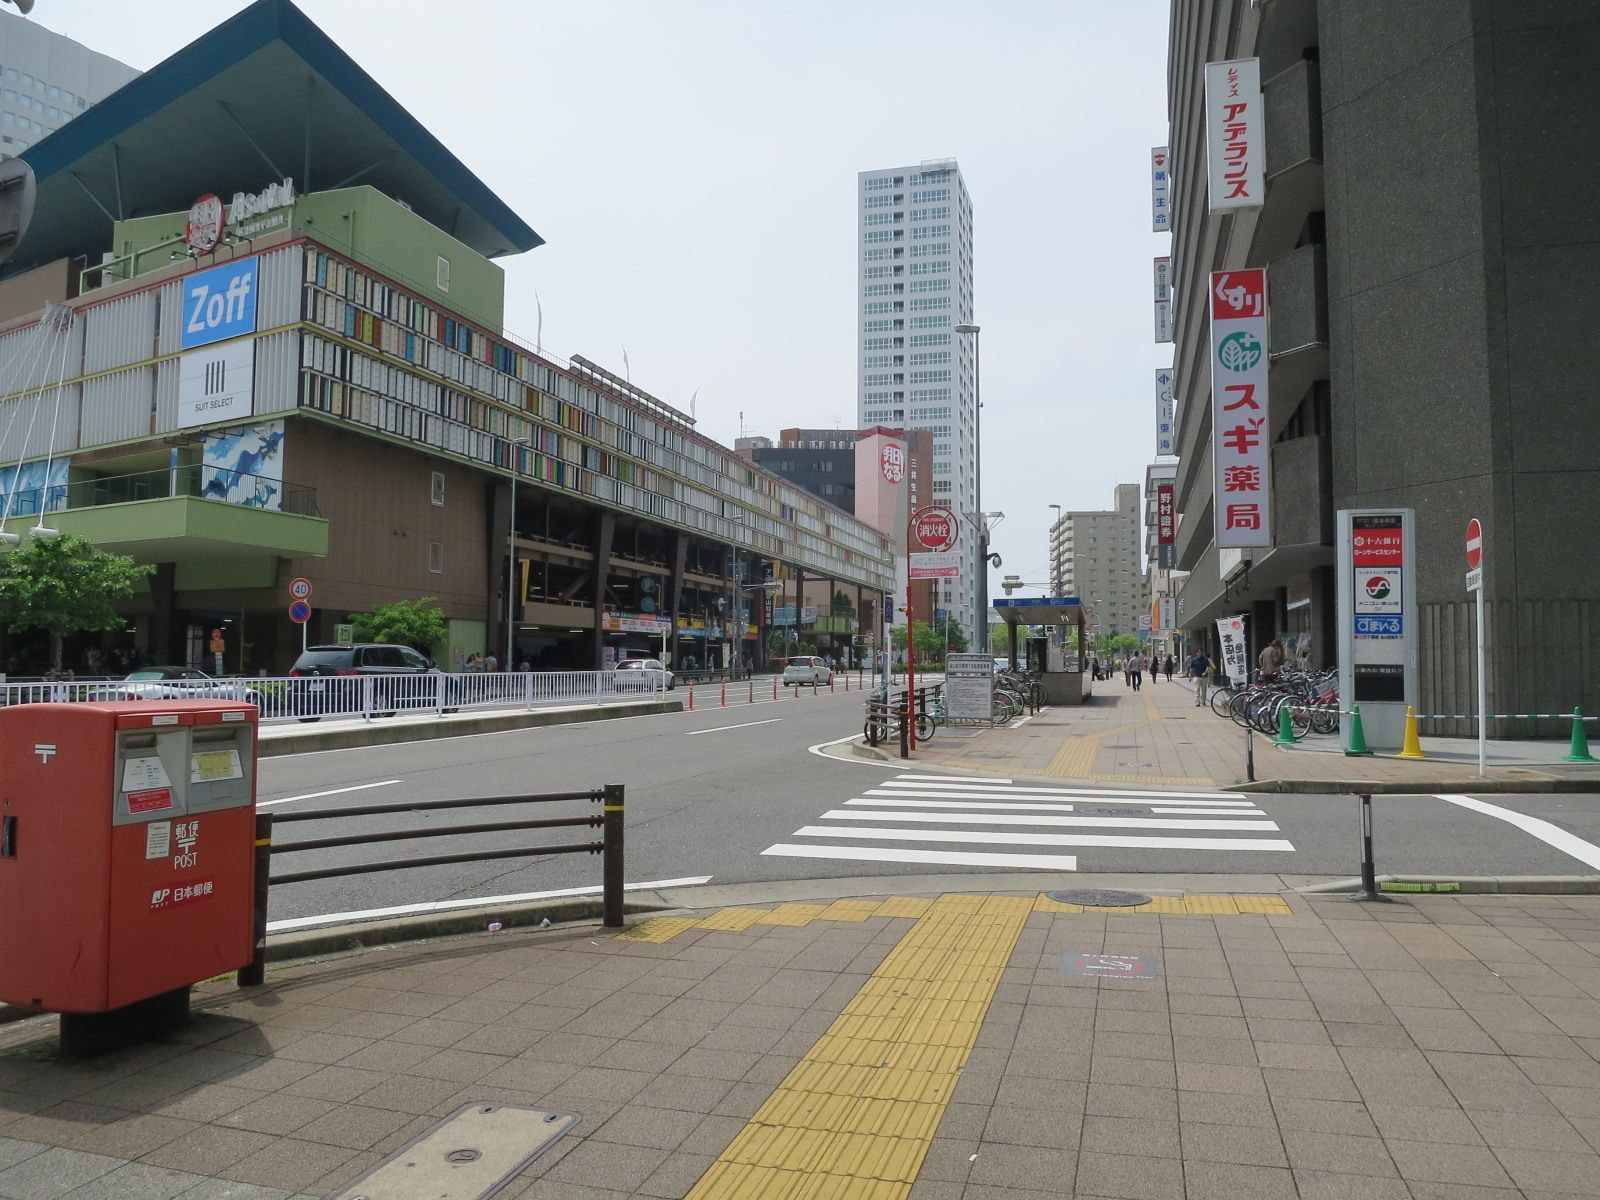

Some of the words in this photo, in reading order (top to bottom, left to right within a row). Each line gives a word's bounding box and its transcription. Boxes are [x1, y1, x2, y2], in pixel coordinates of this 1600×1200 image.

[1227, 67, 1239, 98] レディス
[1222, 103, 1250, 199] アデランス
[1155, 171, 1167, 224] 第一生命
[187, 272, 252, 334] Zoff
[1215, 274, 1262, 316] くすり
[194, 401, 209, 413] SUIT
[210, 397, 234, 410] SELECT
[1223, 384, 1264, 531] スギ薬局
[920, 524, 949, 537] 消火栓
[1365, 537, 1400, 545] 十六銀行
[294, 585, 307, 595] 40
[1357, 618, 1400, 632] すまいる
[175, 821, 199, 841] 郵便
[174, 852, 198, 870] POST
[174, 881, 213, 902] 日本郵便
